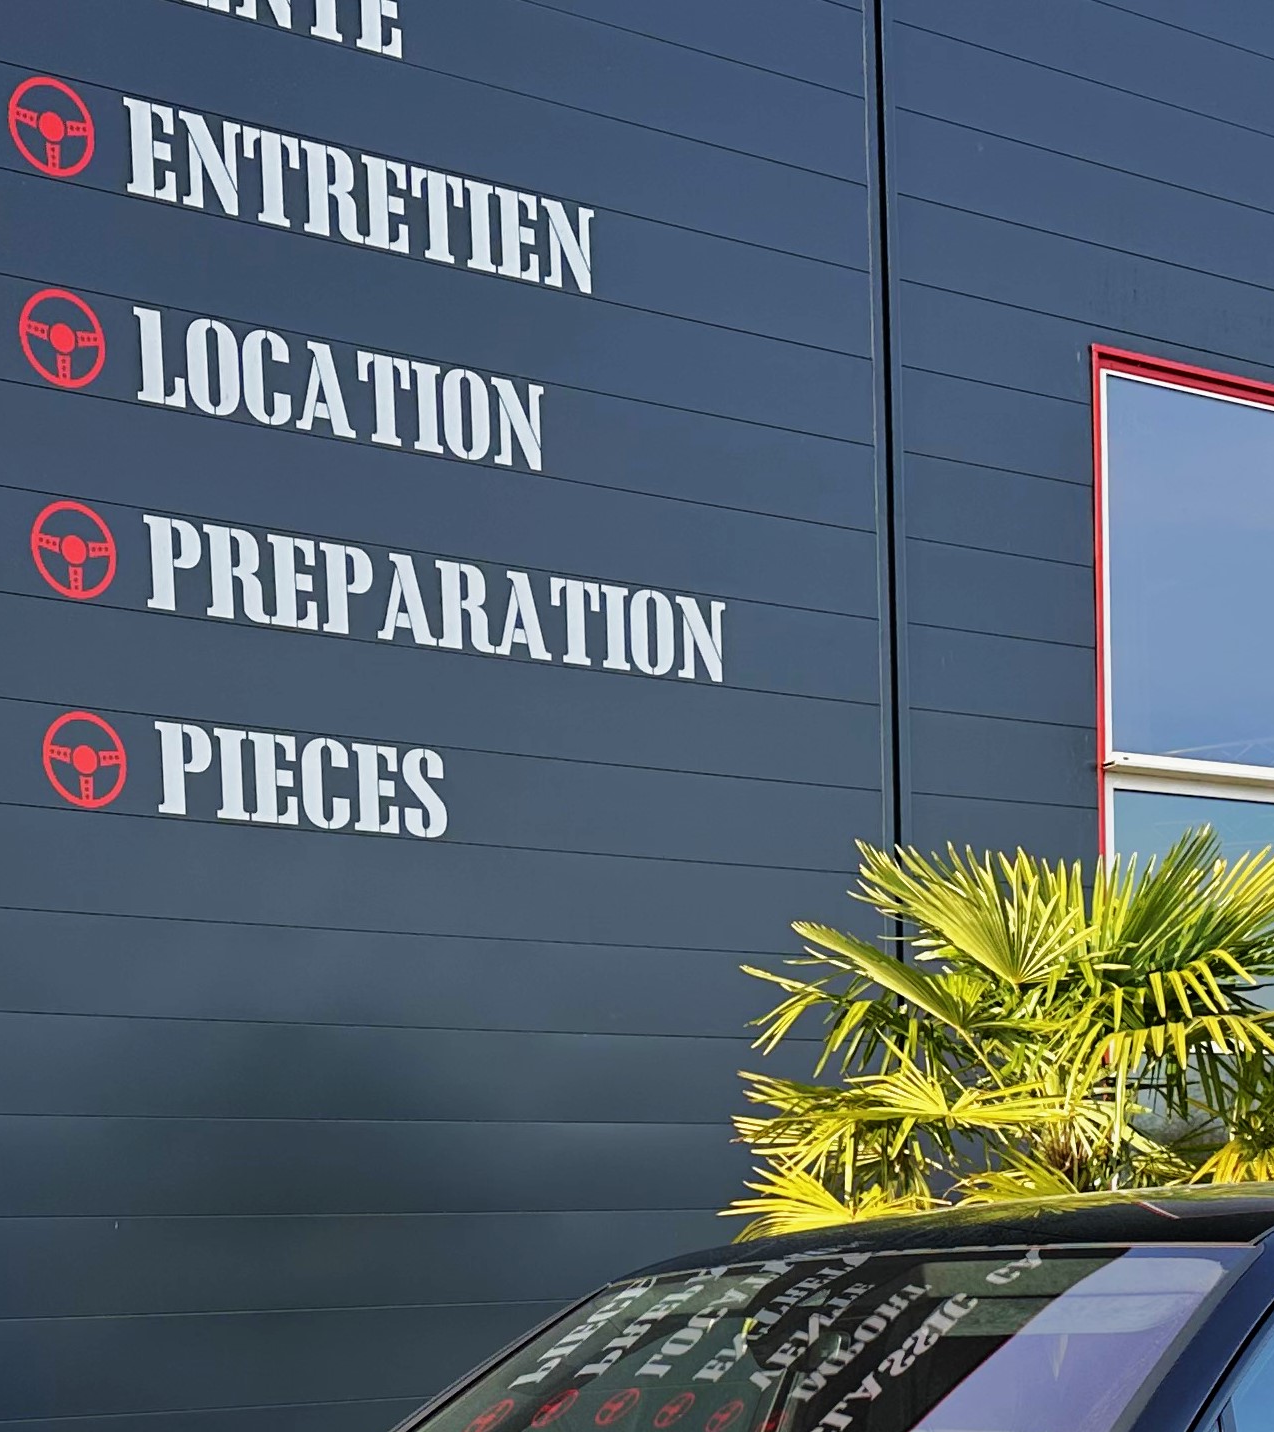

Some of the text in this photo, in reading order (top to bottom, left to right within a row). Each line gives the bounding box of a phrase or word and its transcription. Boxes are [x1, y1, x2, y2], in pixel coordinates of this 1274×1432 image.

[123, 96, 594, 294] ENTRETIEN
[133, 306, 544, 471] LOCATION
[143, 514, 725, 683] PREPARATION
[154, 721, 448, 839] PIECES
